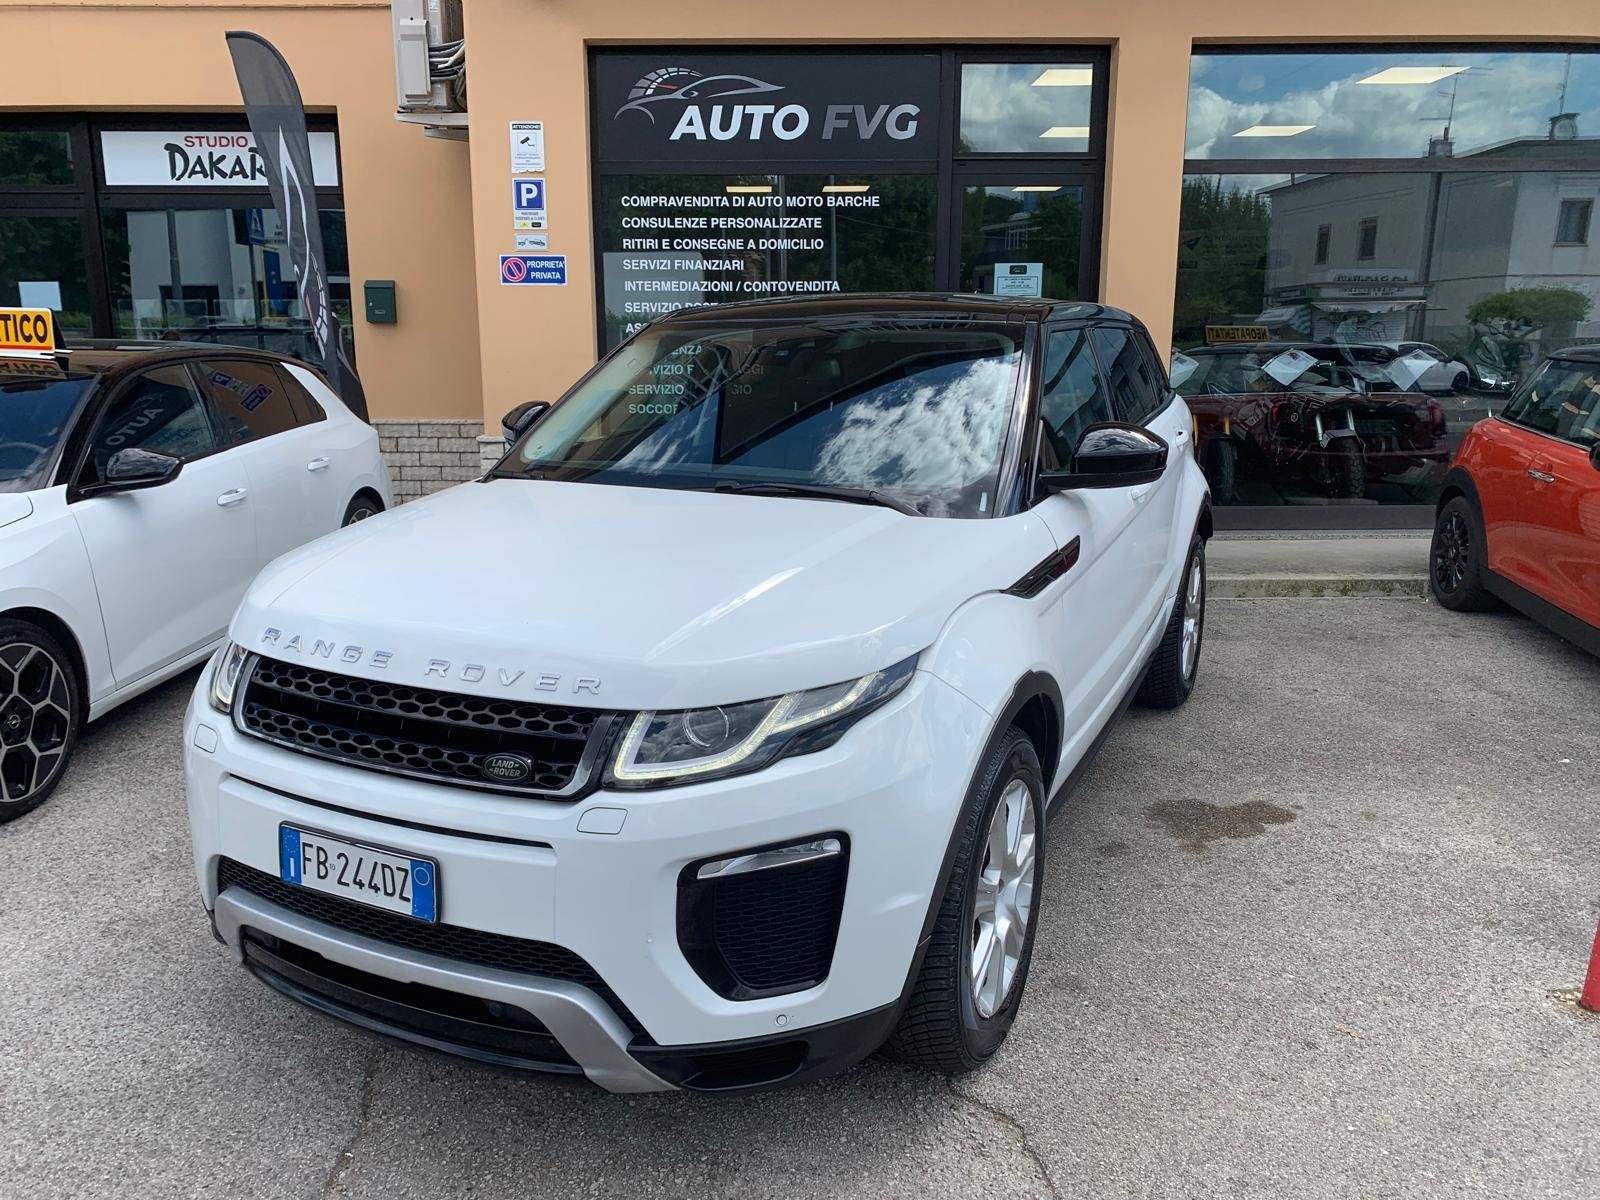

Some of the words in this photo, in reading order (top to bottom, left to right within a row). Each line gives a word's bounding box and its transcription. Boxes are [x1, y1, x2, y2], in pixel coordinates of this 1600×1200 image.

[669, 104, 809, 140] AUTO
[822, 104, 920, 140] FVG
[184, 135, 248, 148] STUDIO
[520, 183, 538, 206] P
[621, 196, 730, 207] COMPRAVENDITA
[732, 196, 745, 207] DI
[748, 196, 783, 207] AUTO
[786, 196, 823, 207] MOTO
[827, 196, 880, 207] BARCHE
[622, 217, 708, 229] CONSULENZE
[711, 217, 822, 229] PERSONALIZZATE
[623, 239, 659, 250] RITIRI
[662, 239, 670, 250] E
[673, 239, 744, 250] CONSEGNE
[747, 239, 756, 250] A
[759, 239, 824, 250] DOMICILIO
[623, 259, 671, 271] SERVIZI
[674, 259, 744, 271] FINANZIARI
[530, 271, 561, 280] PRIVATA
[624, 281, 733, 292] INTERMEDIAZIONI
[743, 281, 840, 292] CONTOVENDITA
[624, 302, 682, 313] SERVIZIO
[0, 313, 48, 344] TICO
[629, 385, 684, 395] SERVIZIO
[261, 627, 394, 669] RANGE
[424, 658, 602, 694] ROVER
[492, 759, 515, 769] LAND
[493, 768, 521, 777] ROVER
